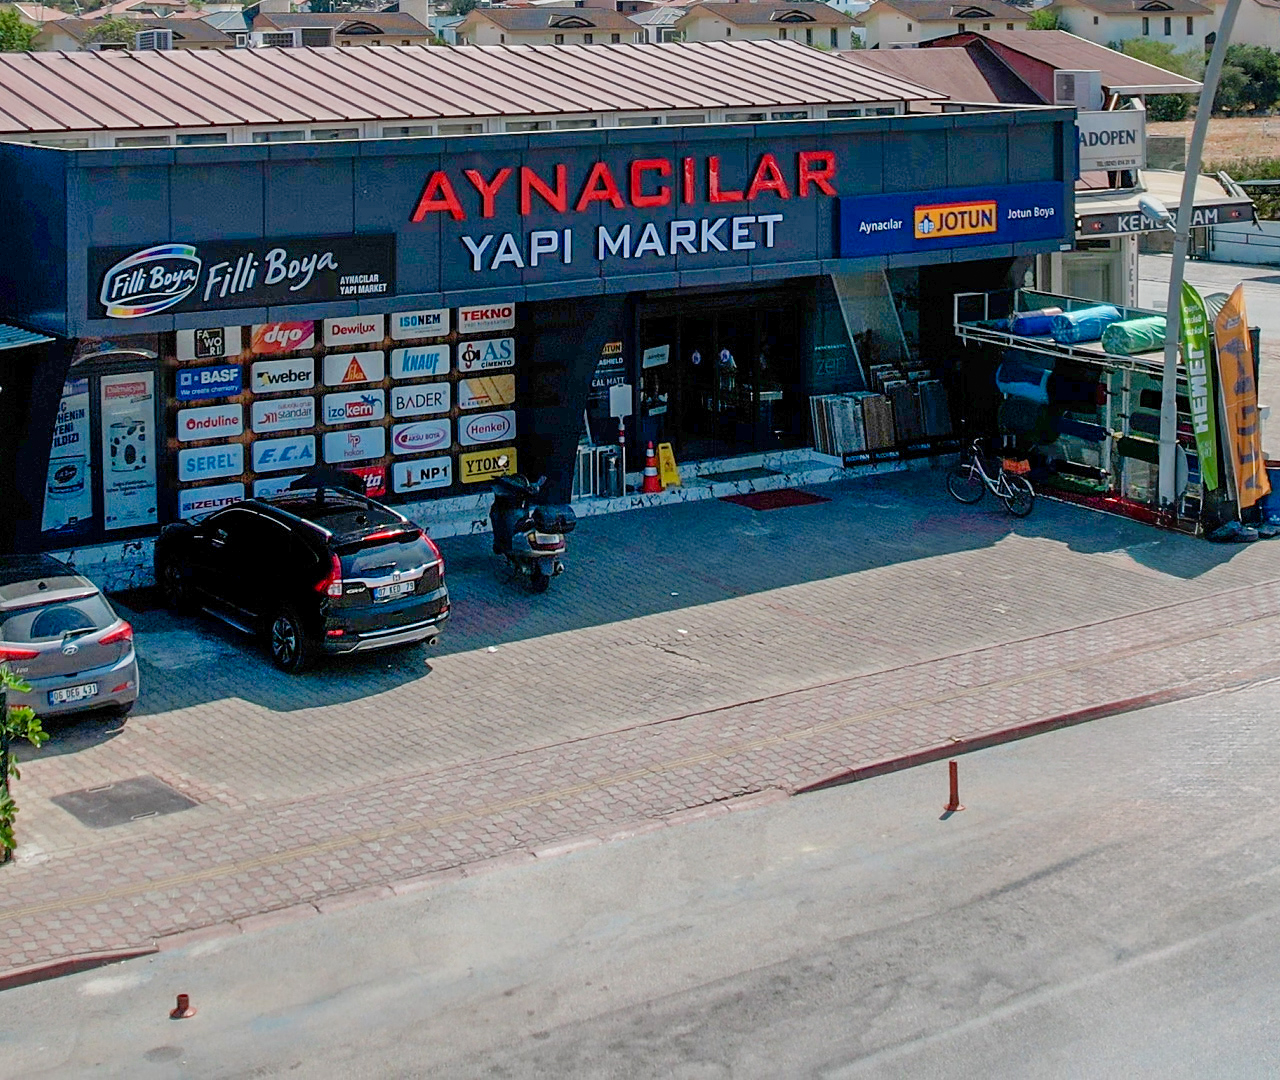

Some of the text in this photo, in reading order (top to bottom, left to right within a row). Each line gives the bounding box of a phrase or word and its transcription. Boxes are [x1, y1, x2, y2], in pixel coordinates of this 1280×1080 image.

[1079, 129, 1137, 147] ADOPEN
[410, 150, 839, 222] AYNACILAR
[936, 209, 994, 232] JOTUN
[1008, 206, 1055, 220] Jotun Boya
[1190, 209, 1218, 226] AM
[859, 219, 903, 234] Aynacılar
[461, 213, 783, 272] YAPI MARKET
[111, 265, 196, 299] Filli Boya
[203, 248, 338, 302] Filli Boya
[340, 274, 379, 285] AYNACILAR
[340, 283, 387, 295] YAPI MARKET
[400, 314, 440, 328] ISONEM
[461, 307, 512, 321] TEKNO
[264, 326, 302, 347] dyo
[332, 322, 375, 336] Dewilux
[483, 340, 511, 362] AS
[201, 369, 238, 384] BASF
[268, 369, 311, 384] weber
[186, 415, 239, 430] Onduline
[471, 421, 506, 434] Henkel
[186, 453, 235, 473] SEREL
